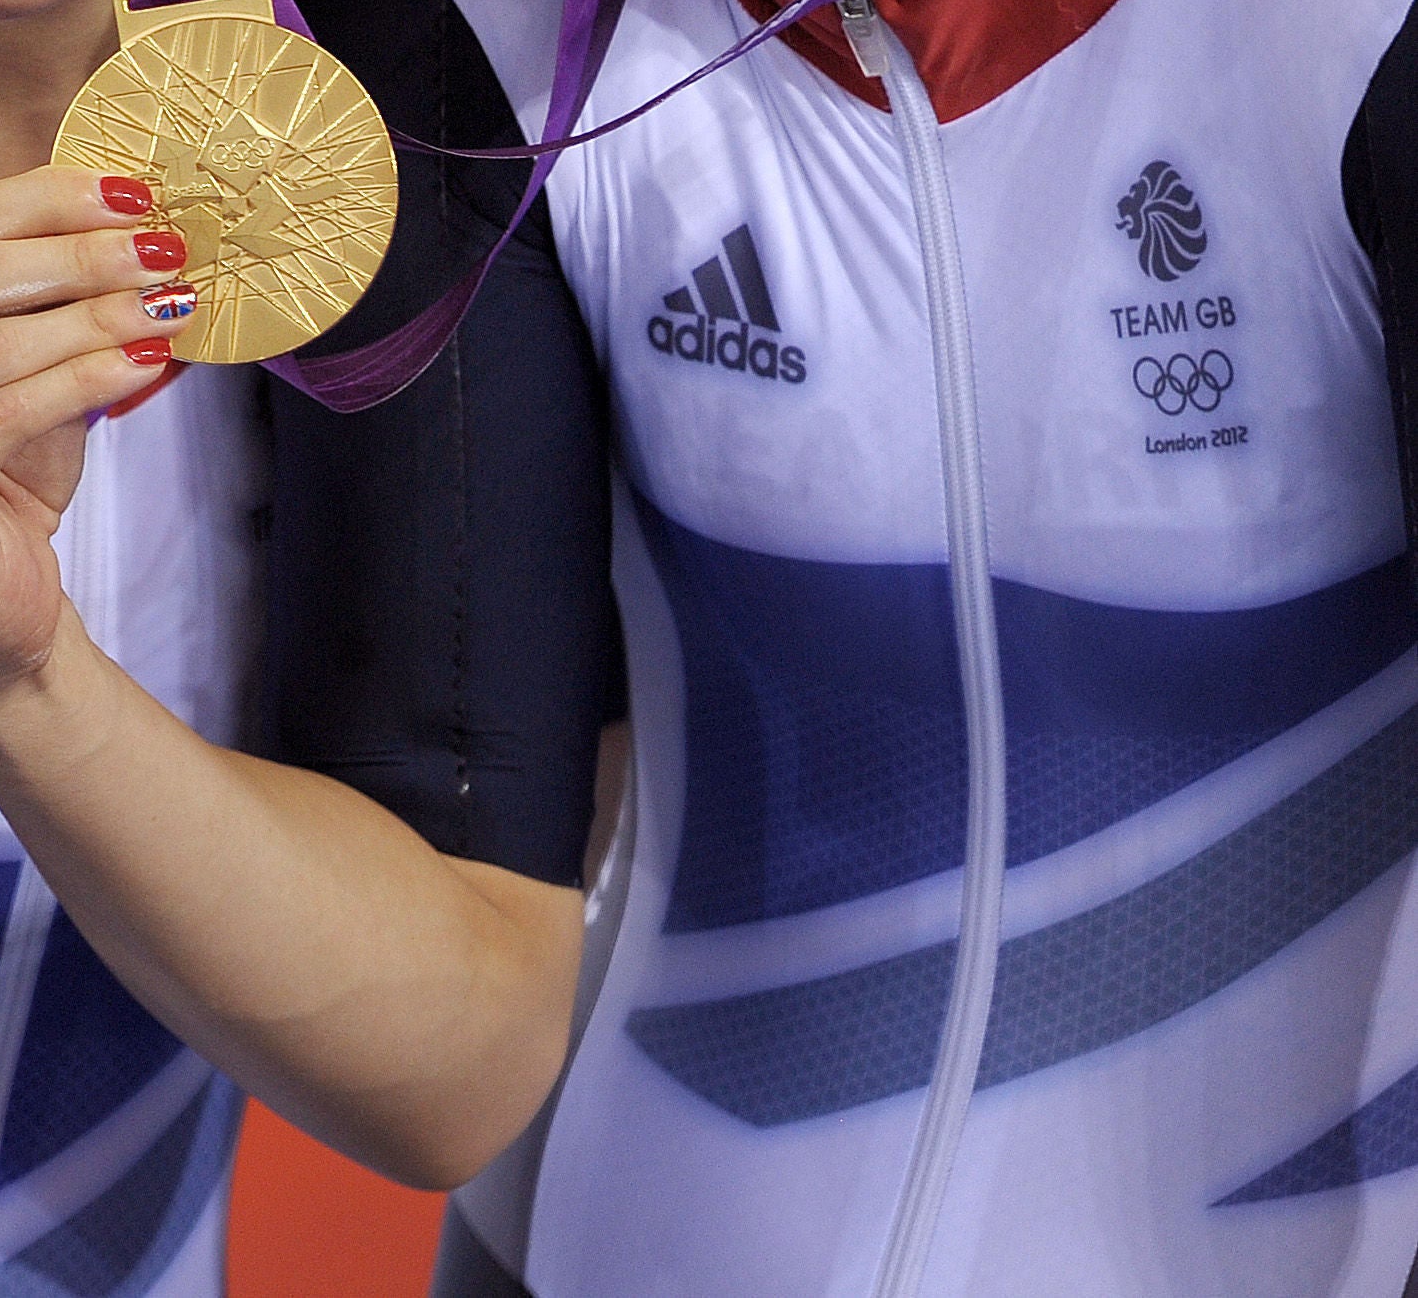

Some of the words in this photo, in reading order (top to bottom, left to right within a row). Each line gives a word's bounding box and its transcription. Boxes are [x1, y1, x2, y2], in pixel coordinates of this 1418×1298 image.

[1110, 300, 1189, 339] TEAM
[1195, 296, 1236, 330] GB
[647, 314, 807, 384] adidas
[1145, 432, 1208, 455] London
[1211, 425, 1249, 448] 2012
